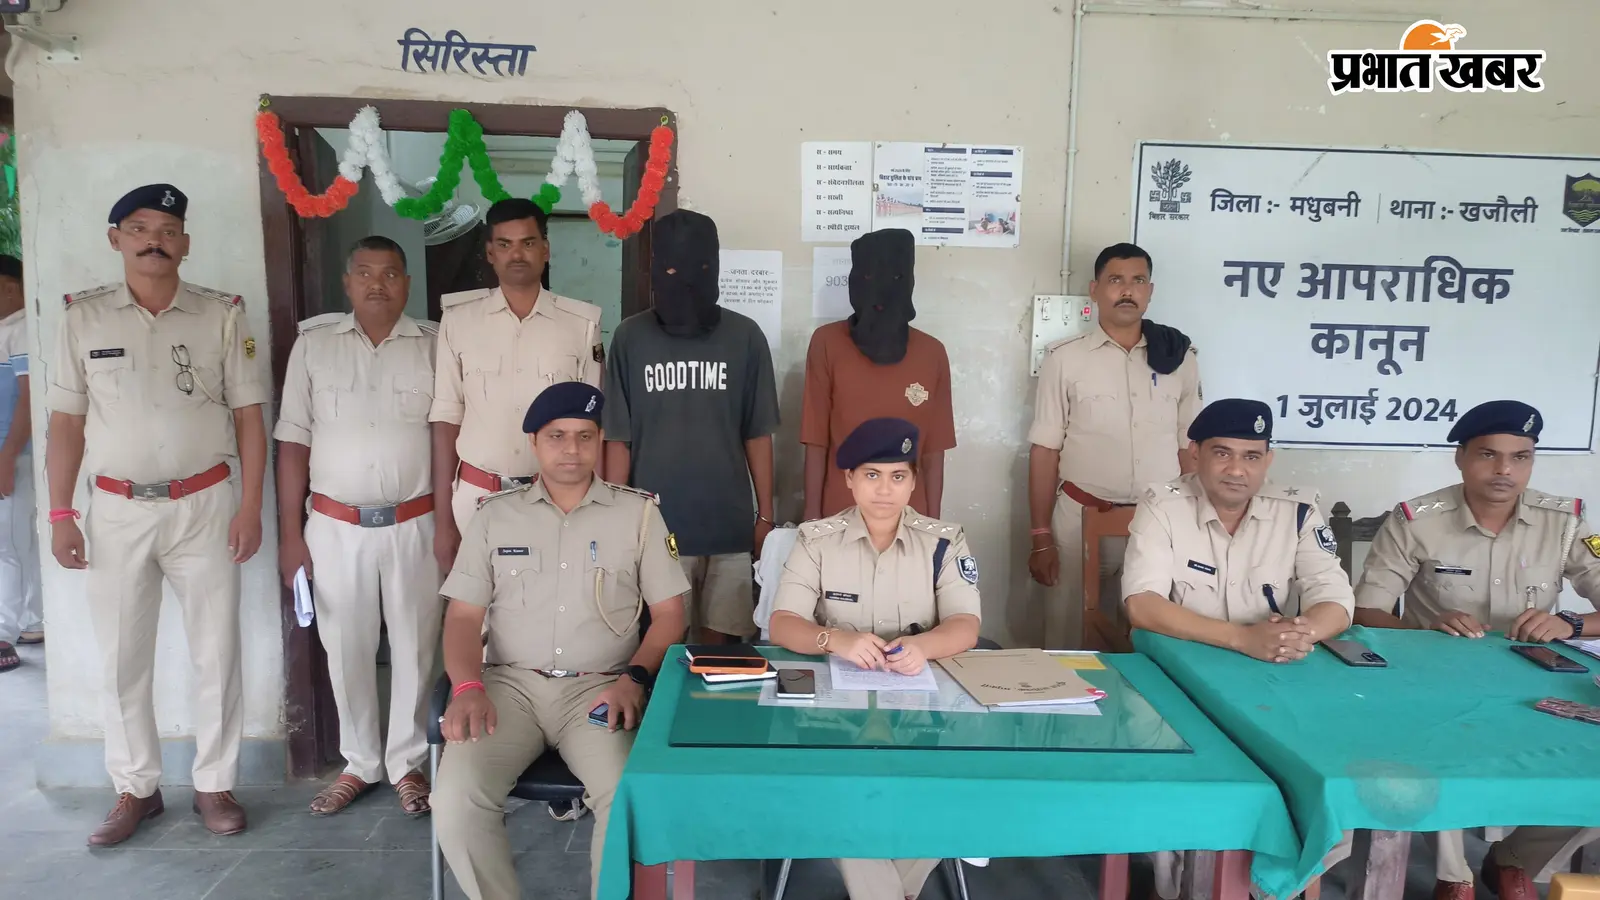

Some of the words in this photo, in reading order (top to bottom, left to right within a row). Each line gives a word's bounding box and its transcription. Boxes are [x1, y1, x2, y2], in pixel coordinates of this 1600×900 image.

[397, 27, 537, 77] सिरिस्ता
[1210, 188, 1262, 213] जिला
[1290, 191, 1361, 222] मधुबनी
[1390, 200, 1436, 219] थाना
[1460, 195, 1539, 223] खजौली
[1223, 260, 1285, 298] नए
[1297, 255, 1514, 304] आपराधिक
[1310, 323, 1430, 376] कानून
[644, 361, 727, 393] GOODTIME
[1277, 395, 1289, 418] 1
[1298, 388, 1379, 428] जुलाई
[1386, 396, 1458, 422] 2024
